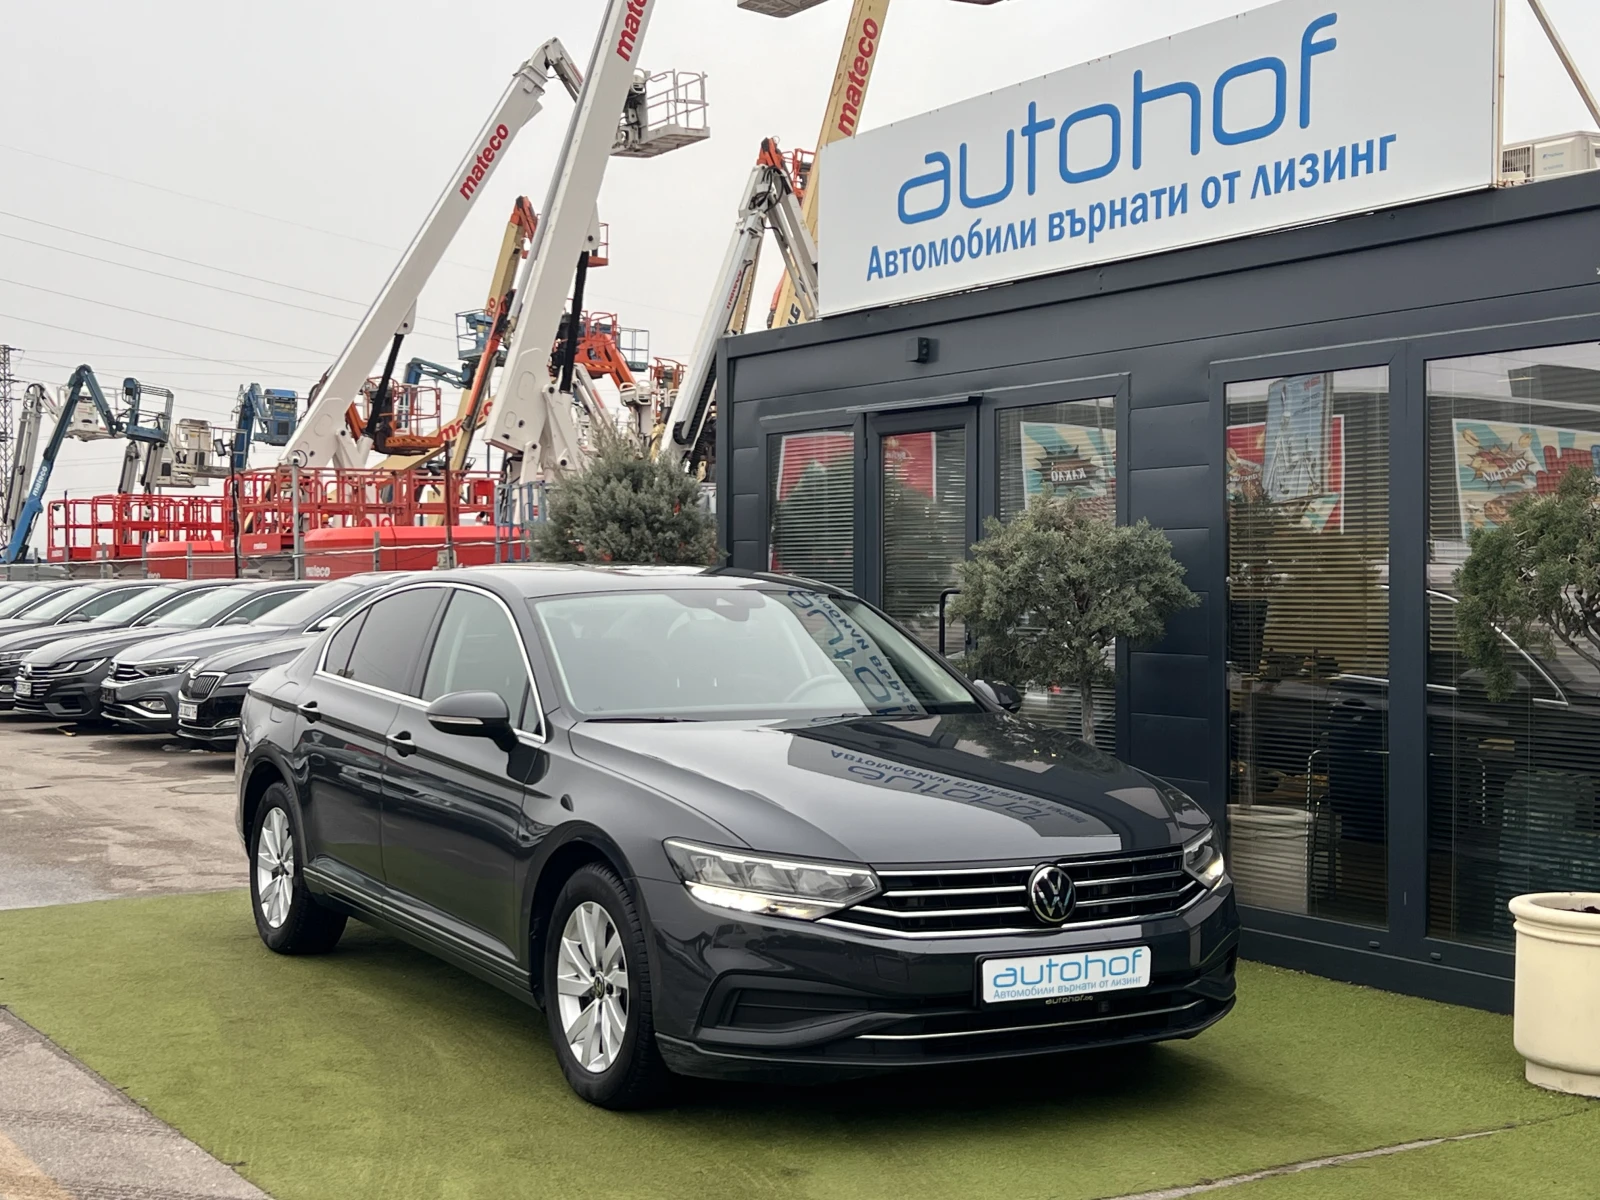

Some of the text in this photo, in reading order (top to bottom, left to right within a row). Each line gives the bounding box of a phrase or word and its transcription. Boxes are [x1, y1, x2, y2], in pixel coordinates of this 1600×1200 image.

[837, 17, 878, 137] mateco
[897, 13, 1338, 225] autohof
[459, 124, 509, 201] mateco
[866, 134, 1397, 281] Автомобили върнати от лизинг
[992, 948, 1143, 988] autohof
[993, 975, 1142, 999] Автомобили върнати от лизинг
